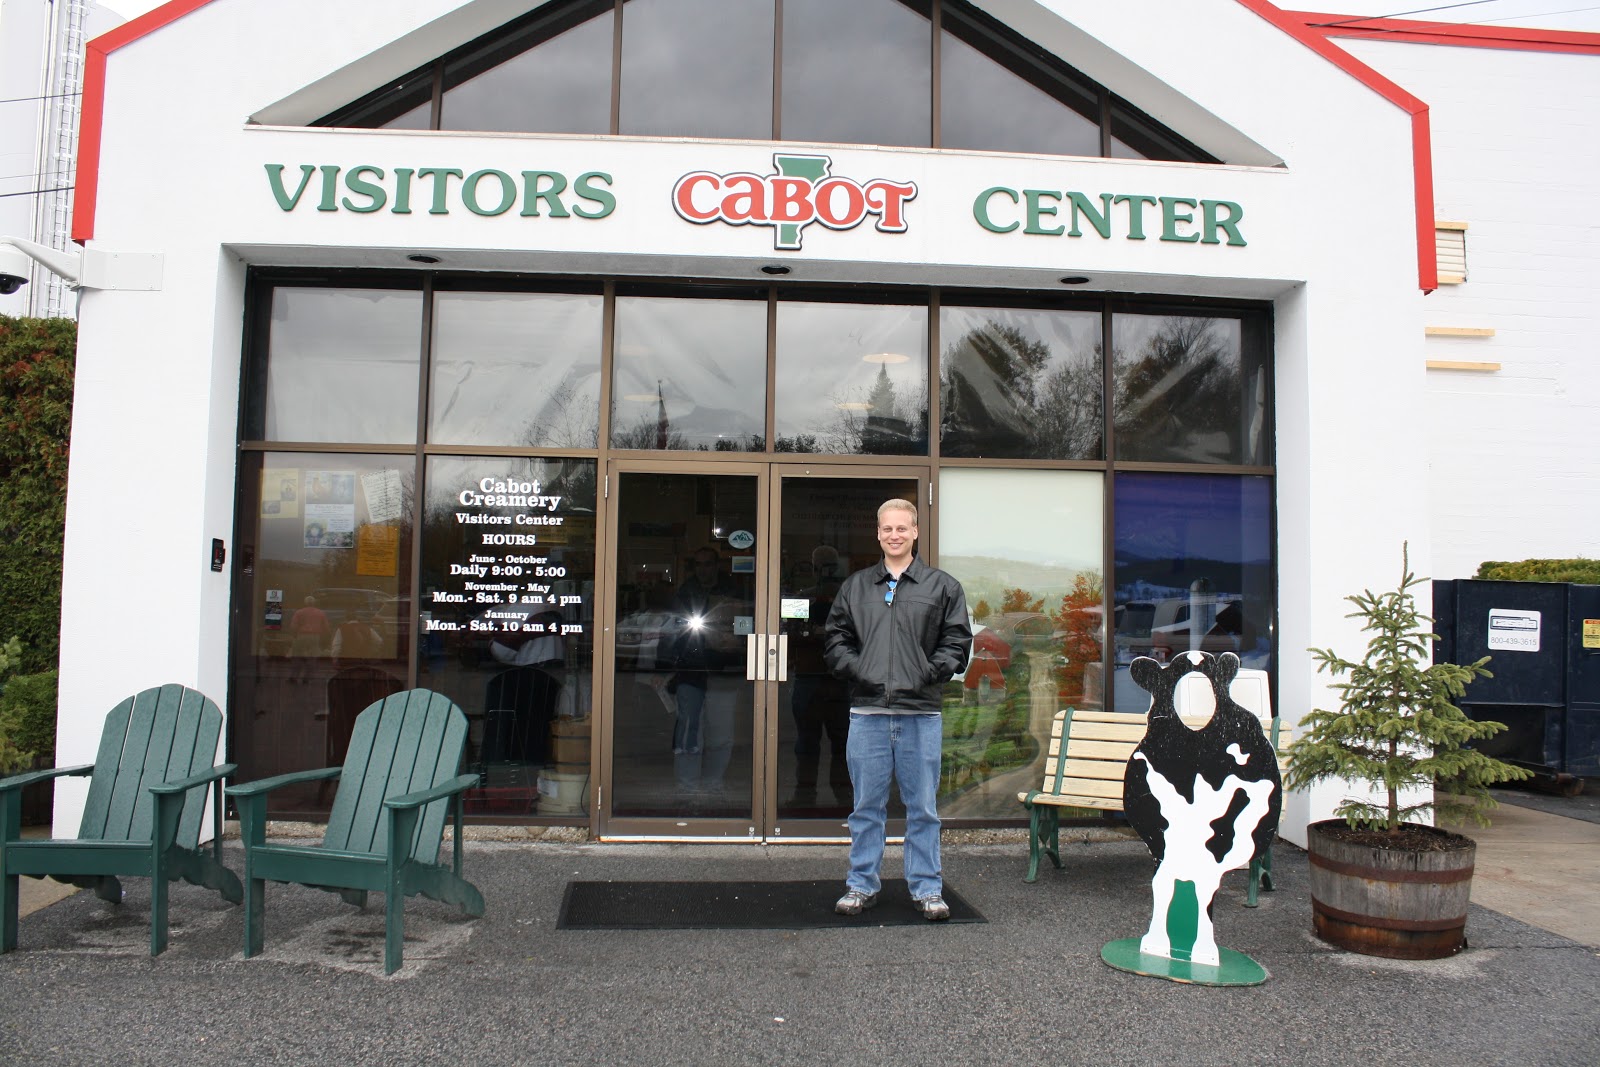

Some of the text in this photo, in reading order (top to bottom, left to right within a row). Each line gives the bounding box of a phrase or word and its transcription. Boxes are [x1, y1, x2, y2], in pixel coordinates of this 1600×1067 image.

[264, 163, 617, 220] VISITORS
[973, 186, 1248, 247] CENTER
[480, 477, 541, 494] Cabot
[459, 490, 561, 511] Creamery
[456, 513, 564, 526] Visitors Center
[482, 534, 536, 546] HOURS
[469, 554, 495, 563] June
[505, 555, 548, 564] October
[450, 564, 488, 577] Daily
[491, 565, 522, 576] 9:00
[535, 567, 566, 577] 5:00
[465, 582, 518, 592] November
[527, 583, 551, 594] May
[476, 593, 504, 604] Sat.
[509, 593, 517, 604] 9
[521, 595, 543, 604] am
[547, 593, 556, 604] 4
[560, 595, 582, 606] pm
[484, 610, 529, 621] January
[470, 621, 498, 632] Sat.
[502, 621, 518, 632] 10
[523, 623, 544, 632] am
[548, 622, 557, 633] 4
[561, 624, 583, 635] pm
